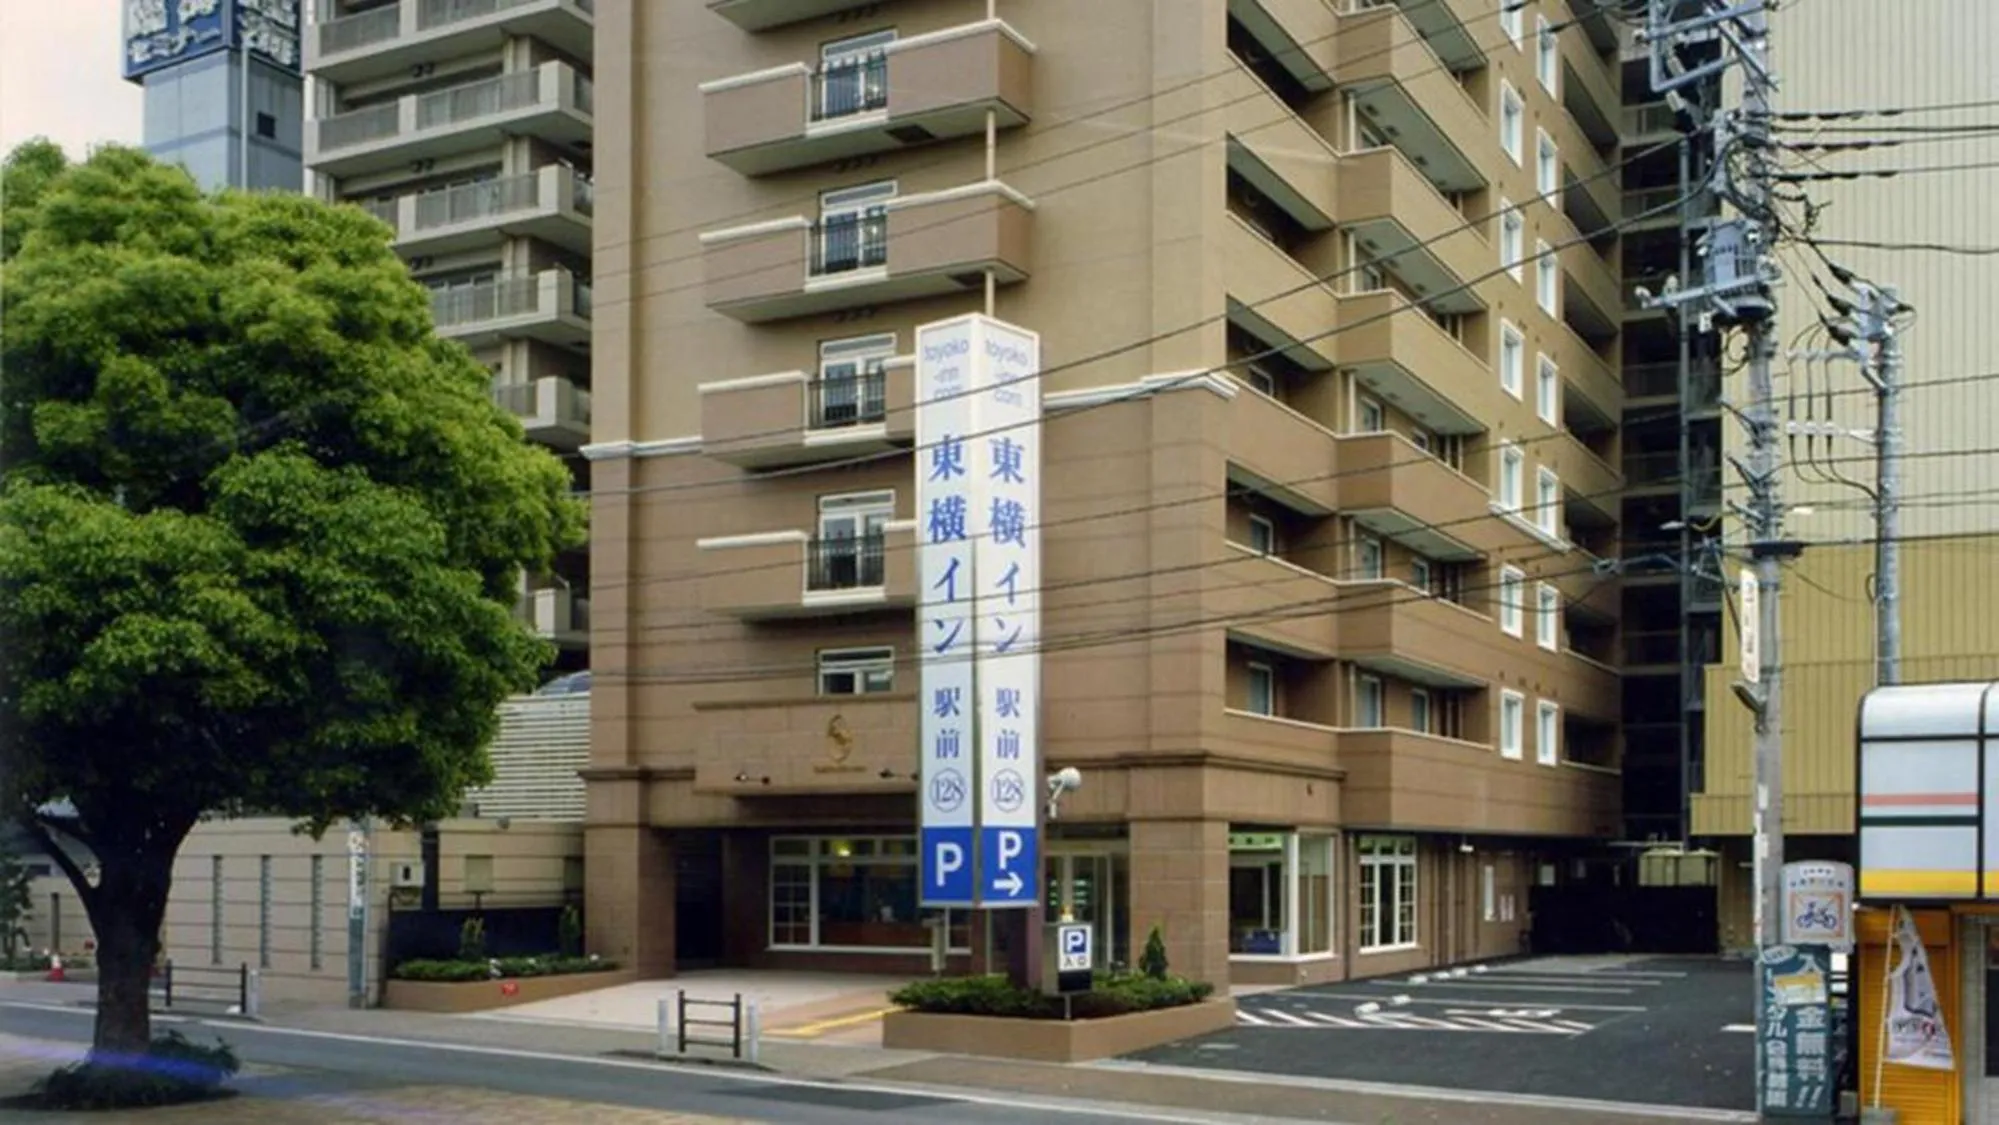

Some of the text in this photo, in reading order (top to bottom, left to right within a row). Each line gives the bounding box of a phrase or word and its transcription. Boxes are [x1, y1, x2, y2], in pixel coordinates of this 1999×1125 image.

[927, 434, 967, 653] 東横イン
[988, 436, 1027, 654] 東横イン
[933, 687, 961, 759] 駅前
[995, 687, 1021, 760] 駅前
[936, 842, 964, 887] P
[999, 831, 1023, 870] P
[1067, 931, 1084, 953] P
